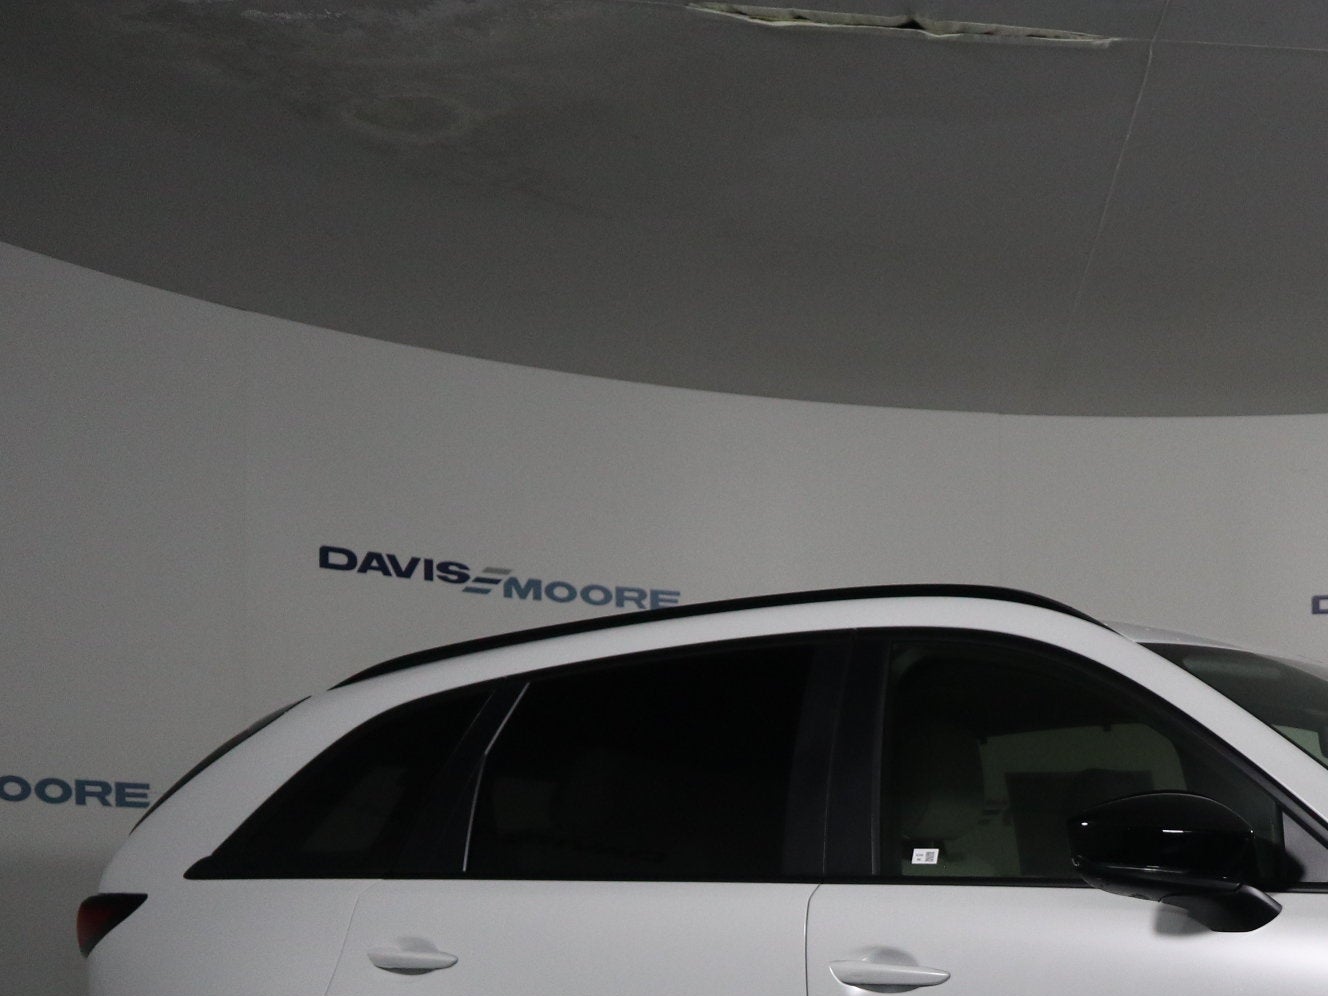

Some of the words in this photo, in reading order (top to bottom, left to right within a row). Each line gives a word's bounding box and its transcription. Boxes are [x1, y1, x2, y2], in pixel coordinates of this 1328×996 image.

[319, 545, 471, 584] DAVIS
[502, 576, 681, 609] MOORE
[0, 775, 150, 808] OORE
